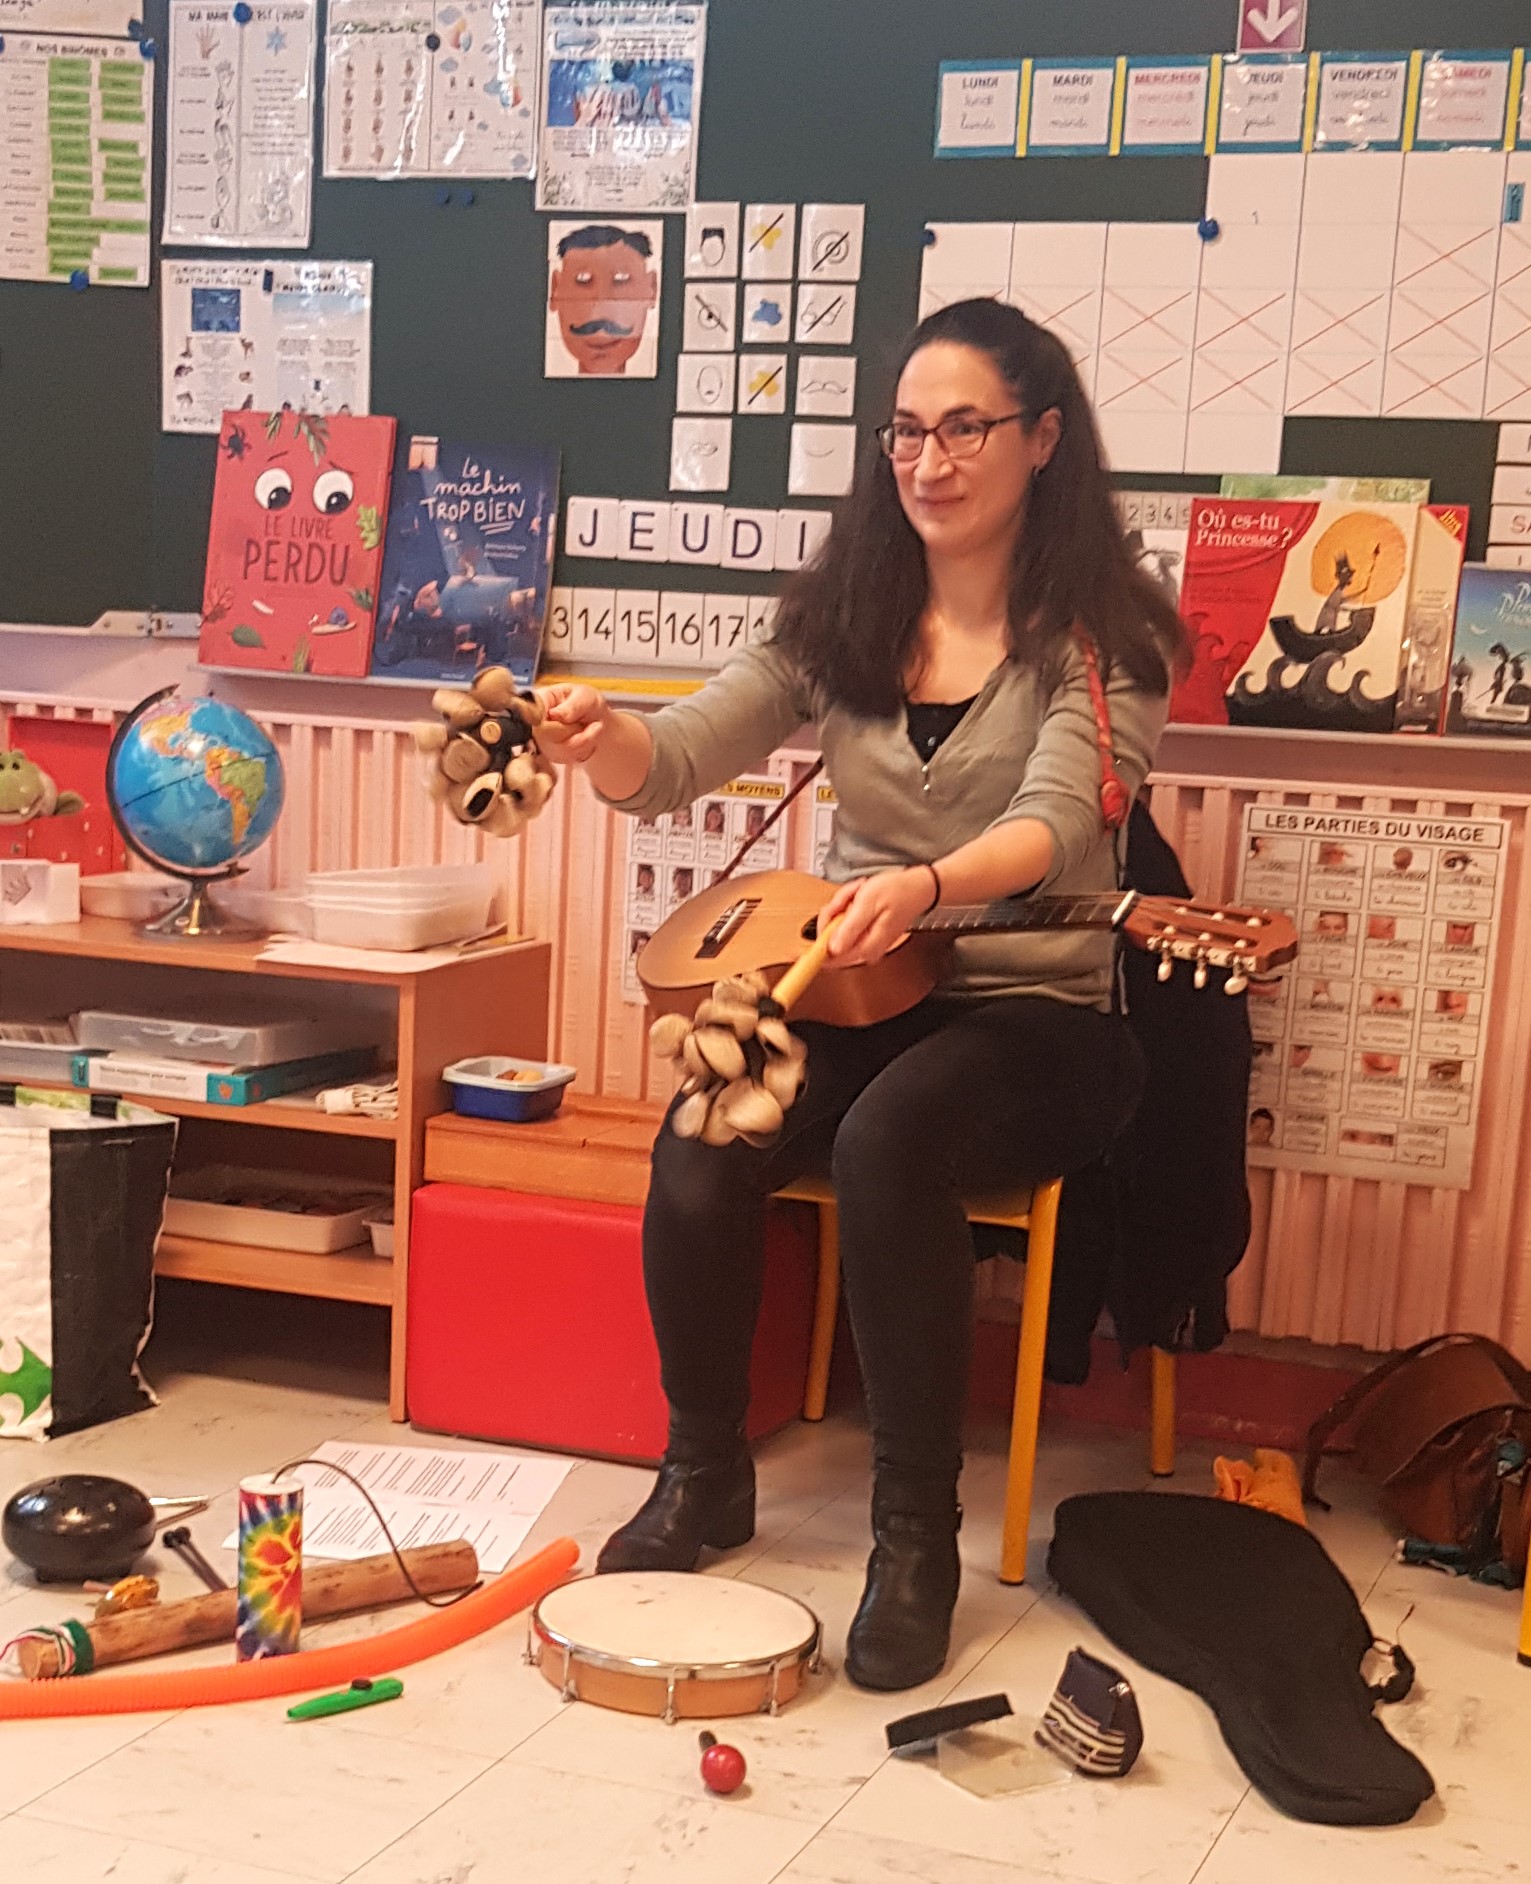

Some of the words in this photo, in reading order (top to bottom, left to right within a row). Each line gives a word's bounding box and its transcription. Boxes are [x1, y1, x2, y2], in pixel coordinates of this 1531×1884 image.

[962, 76, 999, 89] LUNDI
[1052, 74, 1093, 87] MARDI
[1331, 67, 1398, 81] VENDREDI
[461, 457, 480, 479] Le
[434, 469, 521, 497] machin
[419, 497, 470, 521] TROP
[264, 515, 280, 537] LE
[291, 516, 335, 541] LIVRE
[578, 508, 806, 562] JEUDI
[243, 539, 349, 585] PERDU
[550, 605, 570, 639] 3
[577, 607, 613, 640] 14
[620, 610, 655, 643] 15
[664, 612, 700, 645] 16
[708, 614, 745, 647] 17
[736, 783, 781, 796] MOYENS
[1265, 813, 1298, 830] LES
[1303, 815, 1379, 836] PARTIES
[1385, 821, 1410, 838] DU
[1416, 823, 1485, 842] VISAGE
